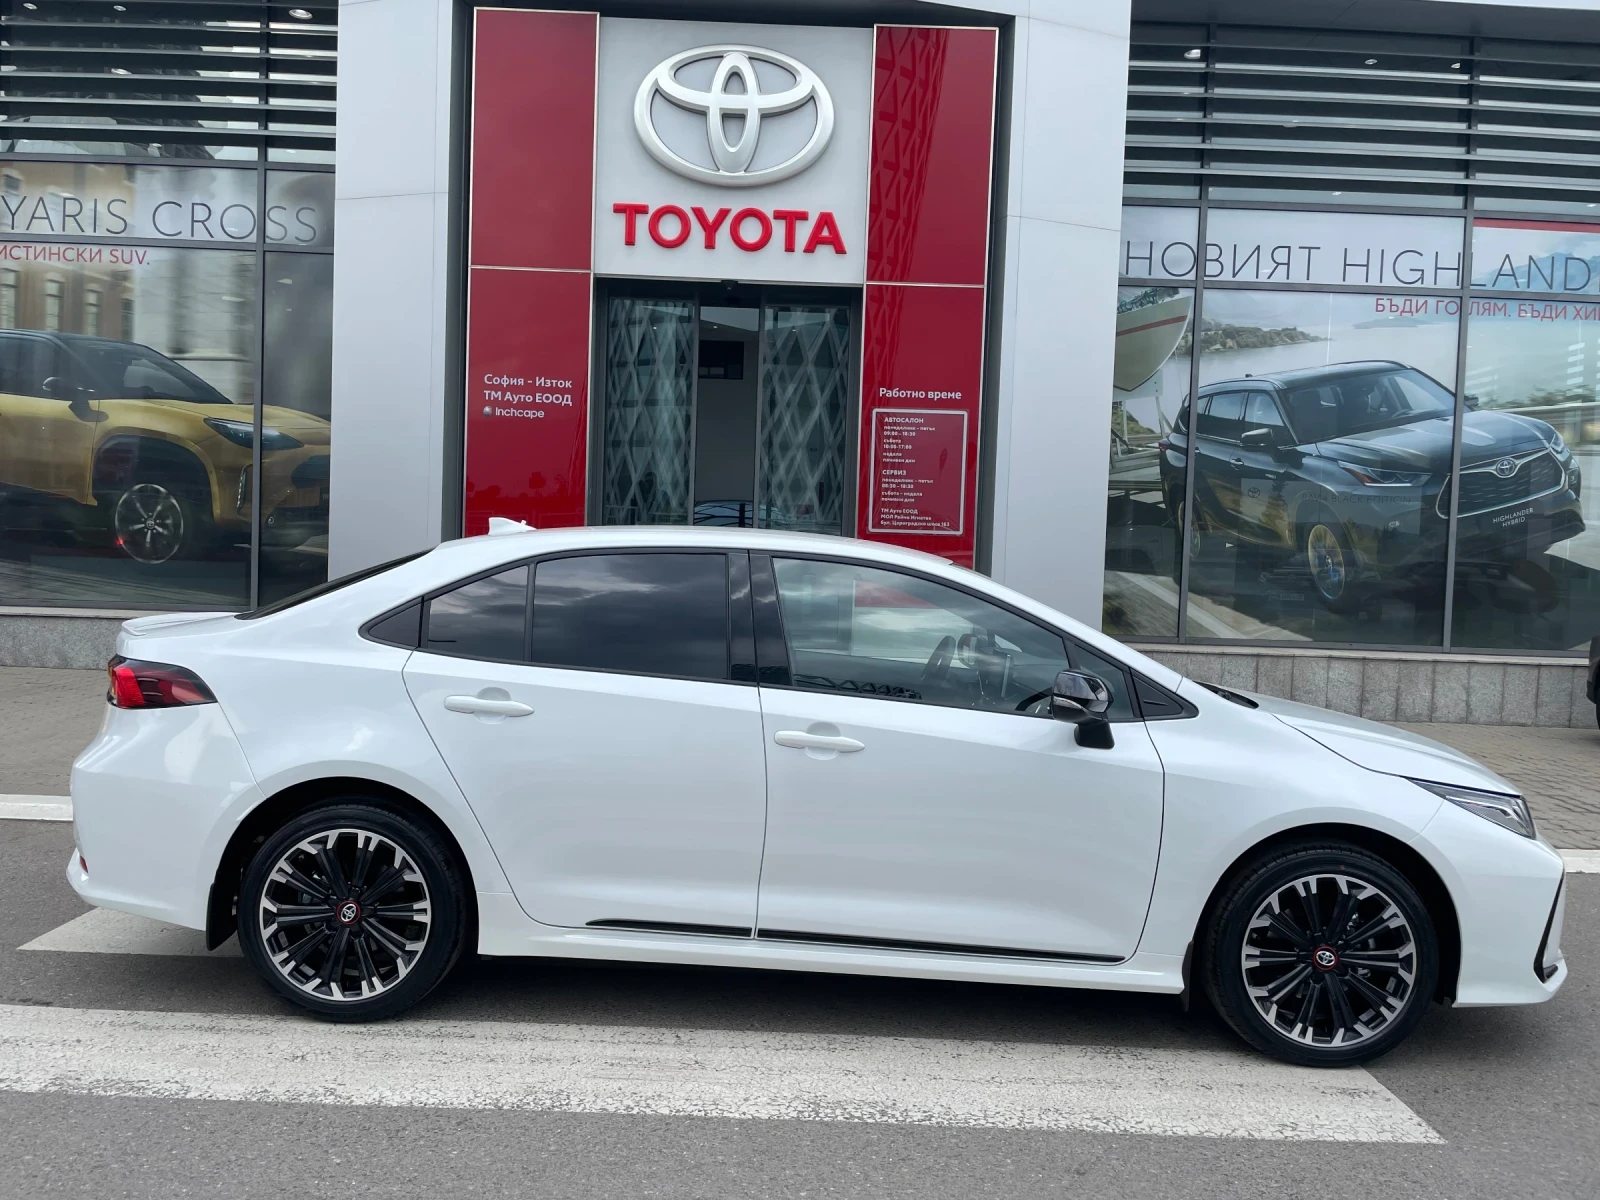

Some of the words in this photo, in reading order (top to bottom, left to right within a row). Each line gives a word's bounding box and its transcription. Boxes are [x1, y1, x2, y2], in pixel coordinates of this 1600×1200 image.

[0, 195, 128, 235] YARIS
[151, 200, 318, 243] CROSS
[612, 202, 848, 255] TOYOTA
[109, 248, 151, 266] SUV.
[1125, 240, 1321, 281] НОВИЯТ
[1341, 247, 1600, 293] HIGHLAND
[1375, 297, 1428, 317] БЪДИ
[1435, 300, 1512, 318] ГОЛЯМ.
[1517, 303, 1567, 322] БЪДИ
[1572, 305, 1600, 322] ХИ
[484, 374, 524, 388] София
[535, 376, 573, 389] Изток
[483, 390, 502, 401] ТМ
[503, 391, 533, 404] Ауто
[535, 392, 573, 407] ЕООД
[879, 387, 926, 398] Работно
[927, 391, 962, 401] време
[495, 407, 545, 419] Inchcape
[1492, 507, 1534, 524] HIGHLANDER
[1502, 516, 1526, 528] HYBRID
